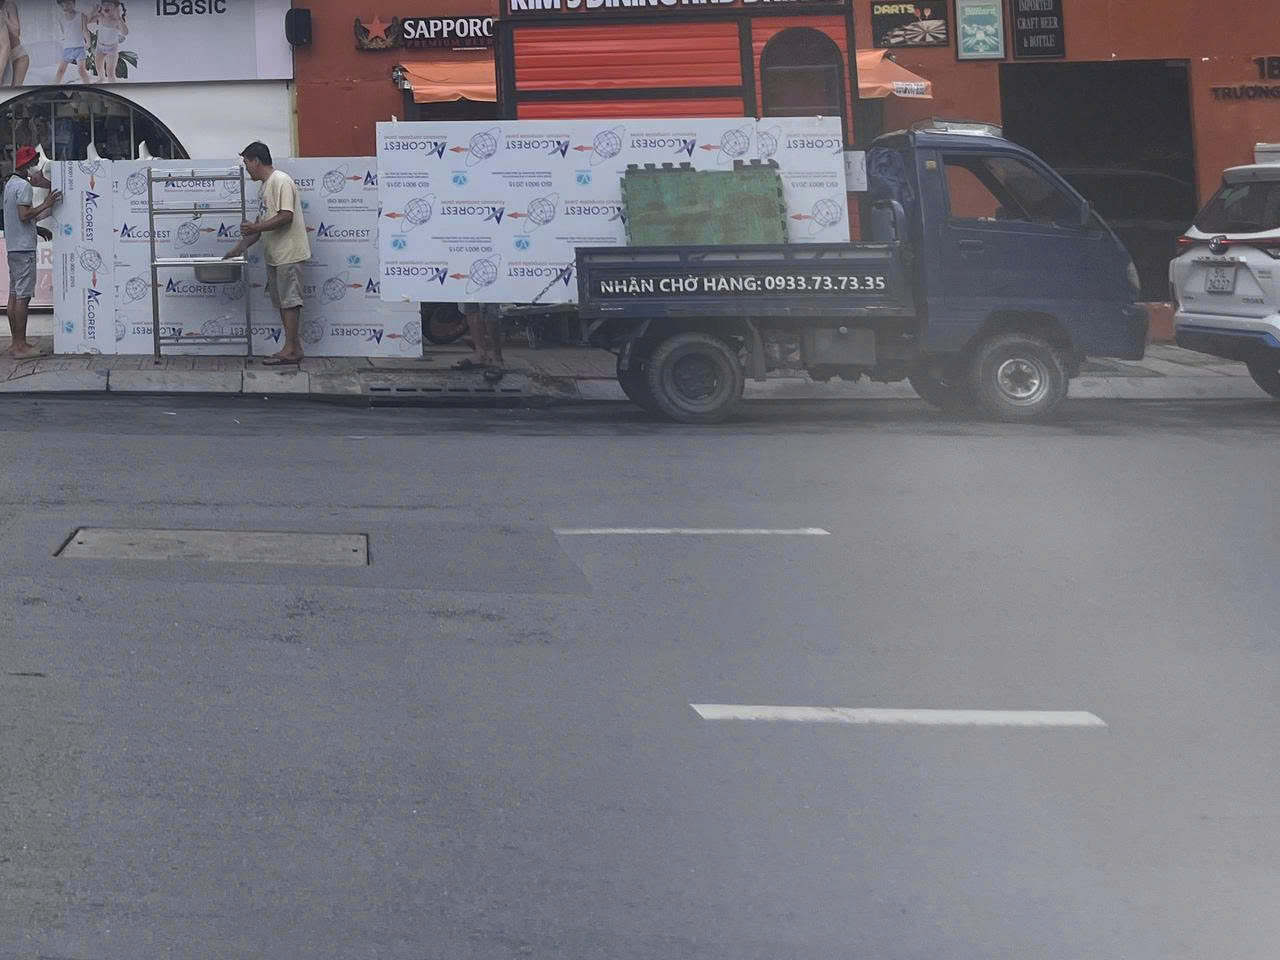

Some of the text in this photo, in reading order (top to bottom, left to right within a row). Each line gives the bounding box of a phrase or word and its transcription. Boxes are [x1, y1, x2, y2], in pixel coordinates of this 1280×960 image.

[873, 4, 915, 15] DARTS
[403, 17, 494, 39] SAPPORO
[384, 141, 447, 160] ALCOREST
[505, 140, 570, 159] ALCOREST
[631, 139, 697, 157] ALCOREST
[786, 139, 843, 155] LCOREST
[164, 172, 216, 189] ALCOREST
[85, 191, 100, 242] ALCOREST
[441, 206, 505, 225] ALCOREST
[317, 221, 371, 238] ALCOREST
[166, 276, 217, 294] ALCOREST
[384, 266, 449, 286] ALCOREST
[508, 267, 573, 287] ALCOREST
[600, 277, 655, 296] NHẬN
[765, 276, 886, 291] 0933.73.73.35
[87, 288, 103, 341] ALCOREST
[132, 326, 184, 343] ALCREST
[231, 327, 282, 344] ALCOEST
[330, 327, 384, 345] ALCOREST
